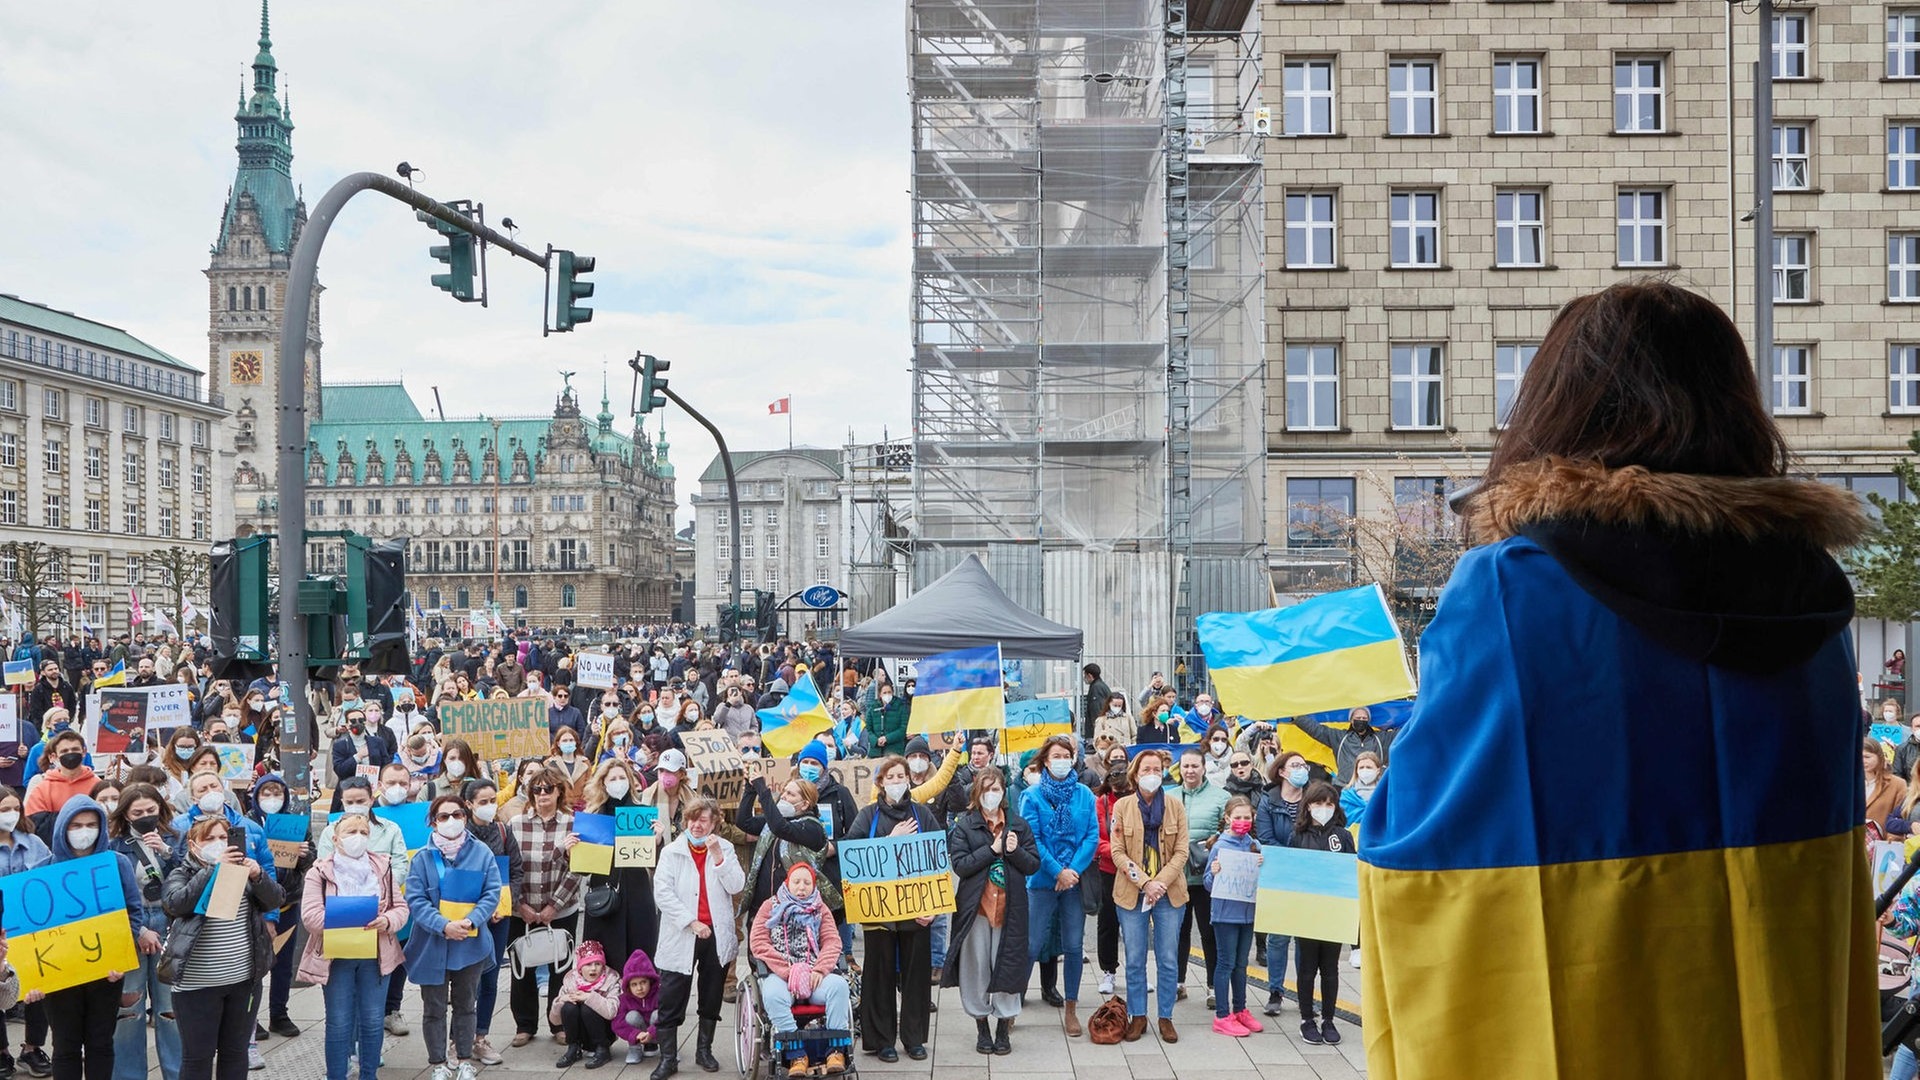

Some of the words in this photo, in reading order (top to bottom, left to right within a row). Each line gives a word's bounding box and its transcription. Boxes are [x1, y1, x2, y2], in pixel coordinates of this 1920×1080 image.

[580, 660, 592, 671] NO
[595, 662, 612, 673] WAR
[153, 690, 183, 698] TECT
[154, 704, 180, 712] OVER
[441, 702, 508, 735] EMBARGO
[1872, 726, 1899, 736] STOP
[510, 728, 549, 757] GAS
[685, 736, 731, 756] STOP
[696, 757, 743, 781] WAR
[702, 781, 743, 800] NOW
[1328, 834, 1342, 852] C
[619, 846, 653, 861] SKY
[844, 845, 888, 879] STOP
[893, 838, 948, 878] KILLING
[5, 864, 116, 932] OSE
[859, 885, 893, 918] OUR
[895, 878, 952, 916] PEOPLE
